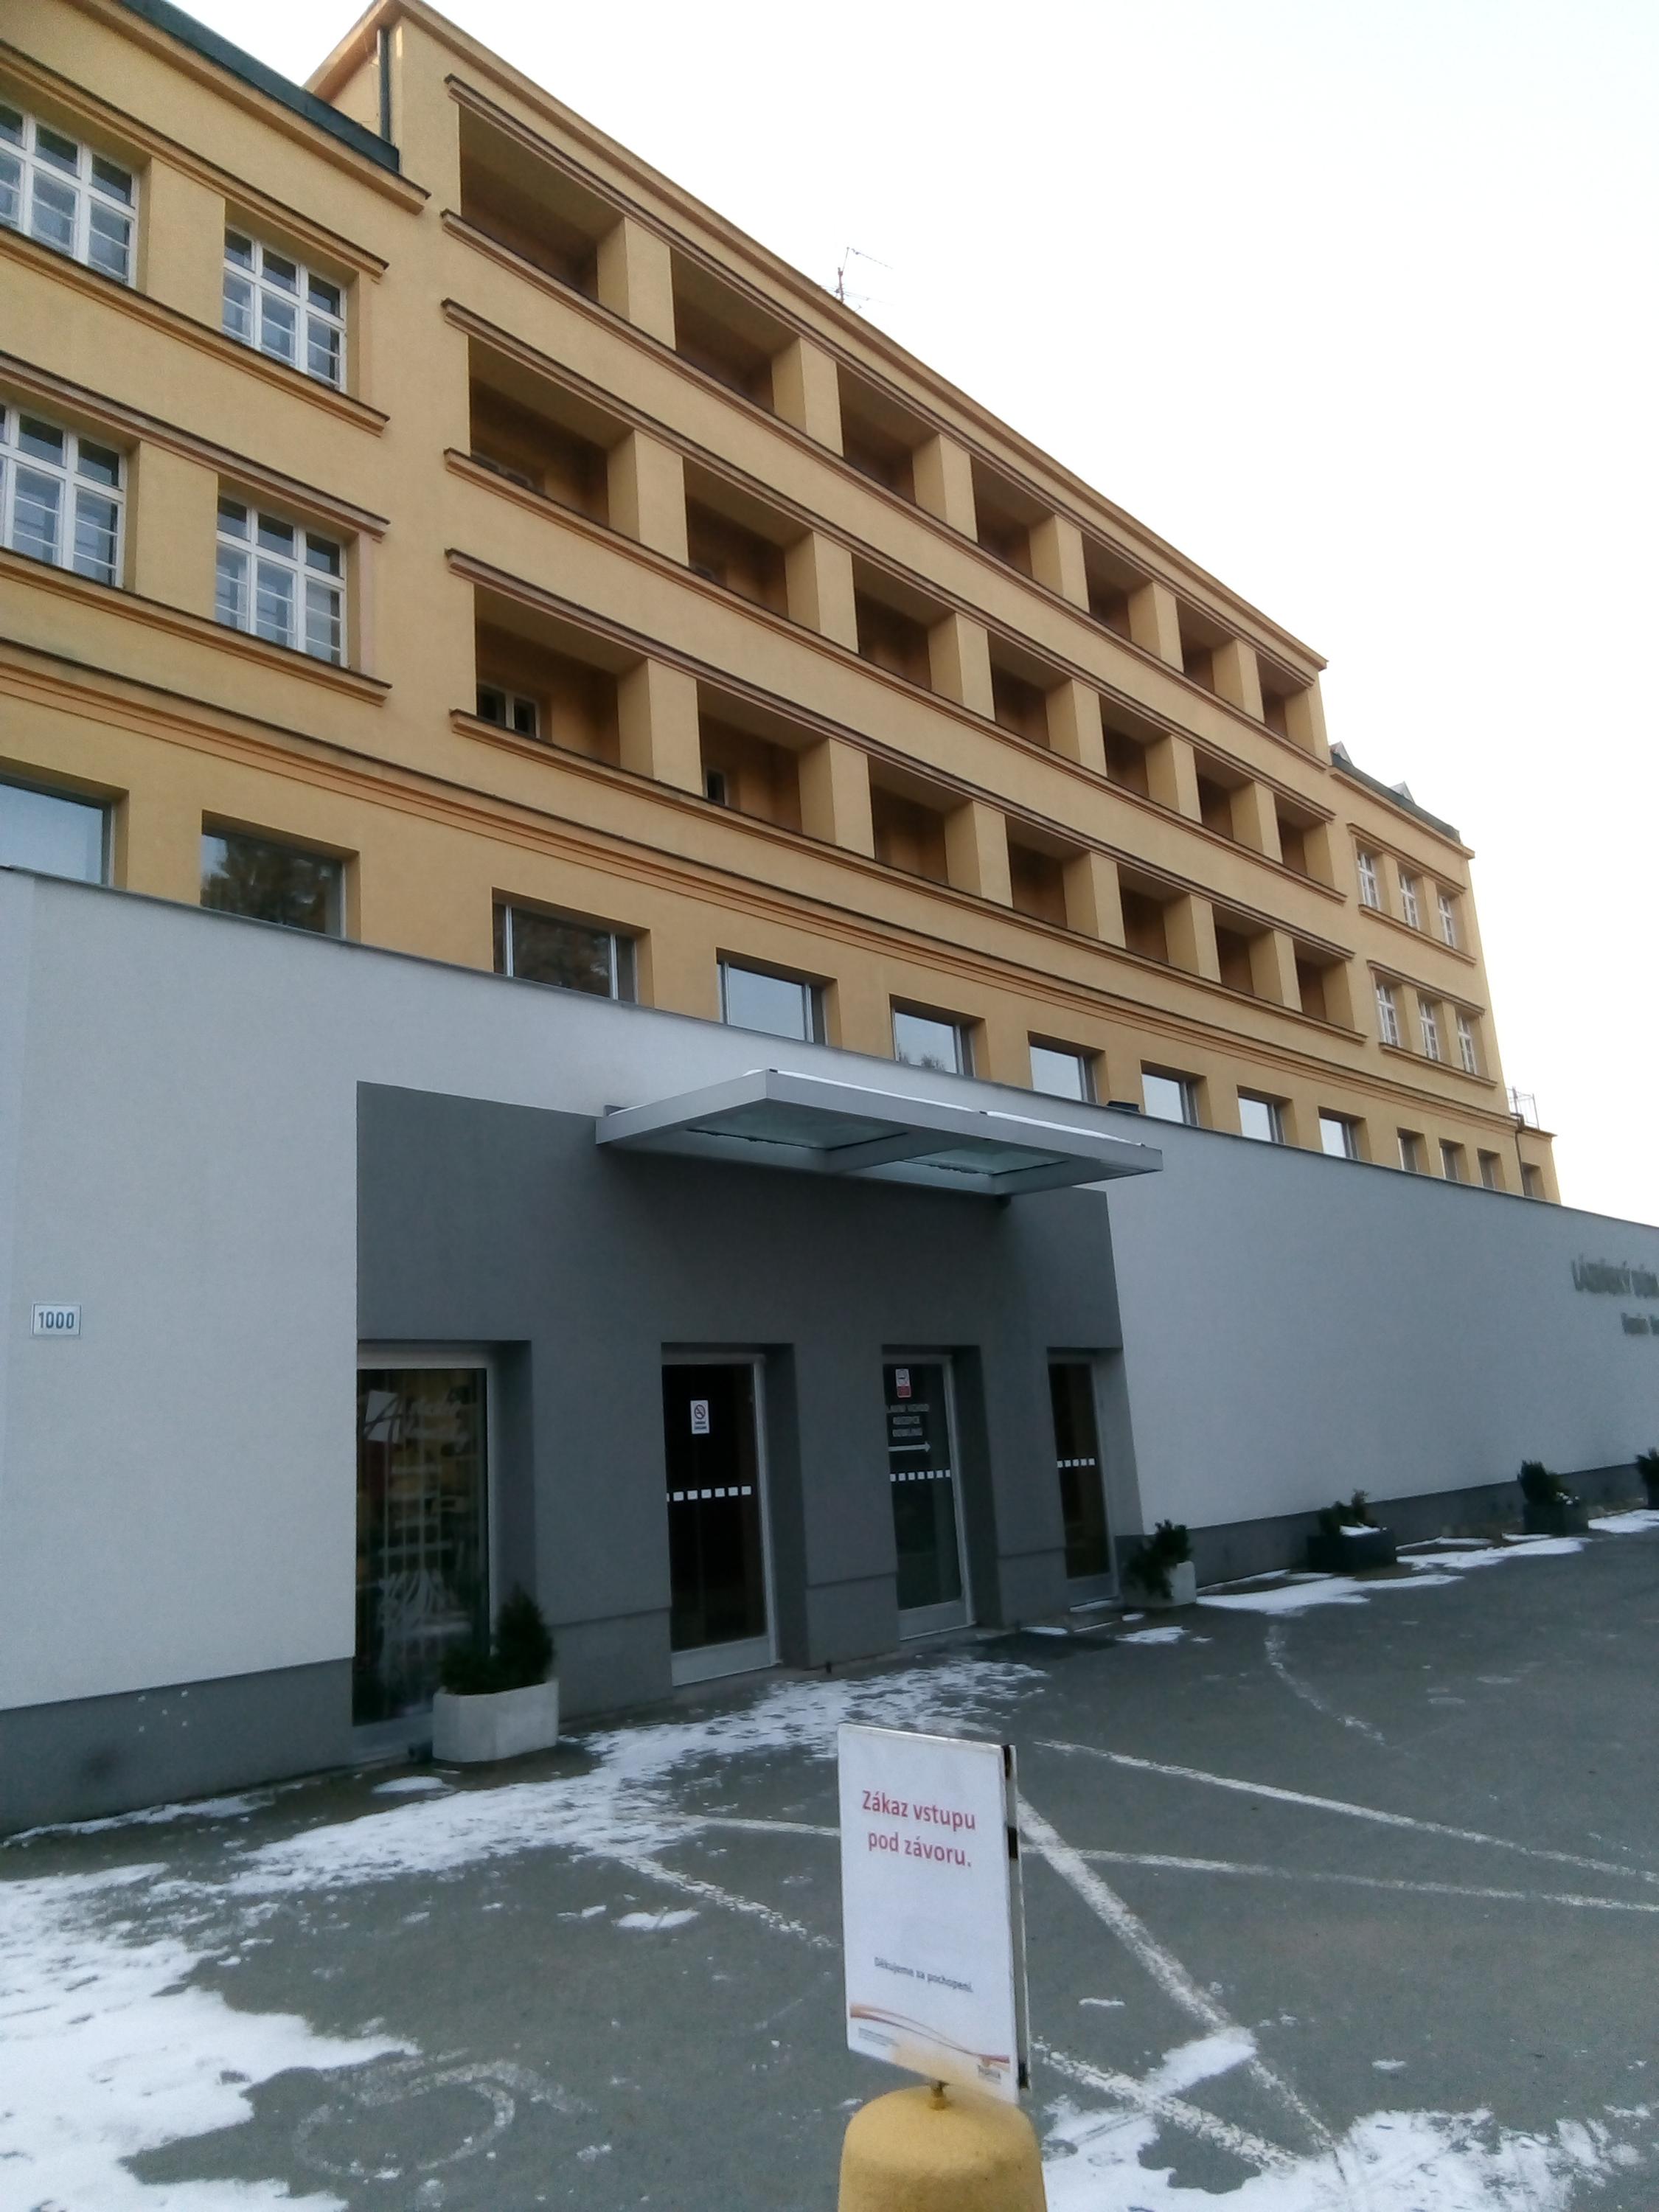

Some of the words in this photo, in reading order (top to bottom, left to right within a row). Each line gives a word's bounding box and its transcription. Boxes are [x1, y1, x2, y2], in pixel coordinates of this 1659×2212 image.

[38, 1311, 74, 1329] 1000
[862, 1790, 908, 1818] Zákaz
[913, 1804, 975, 1832] vstupu
[868, 1831, 899, 1852] pod
[904, 1835, 972, 1868] závoru.
